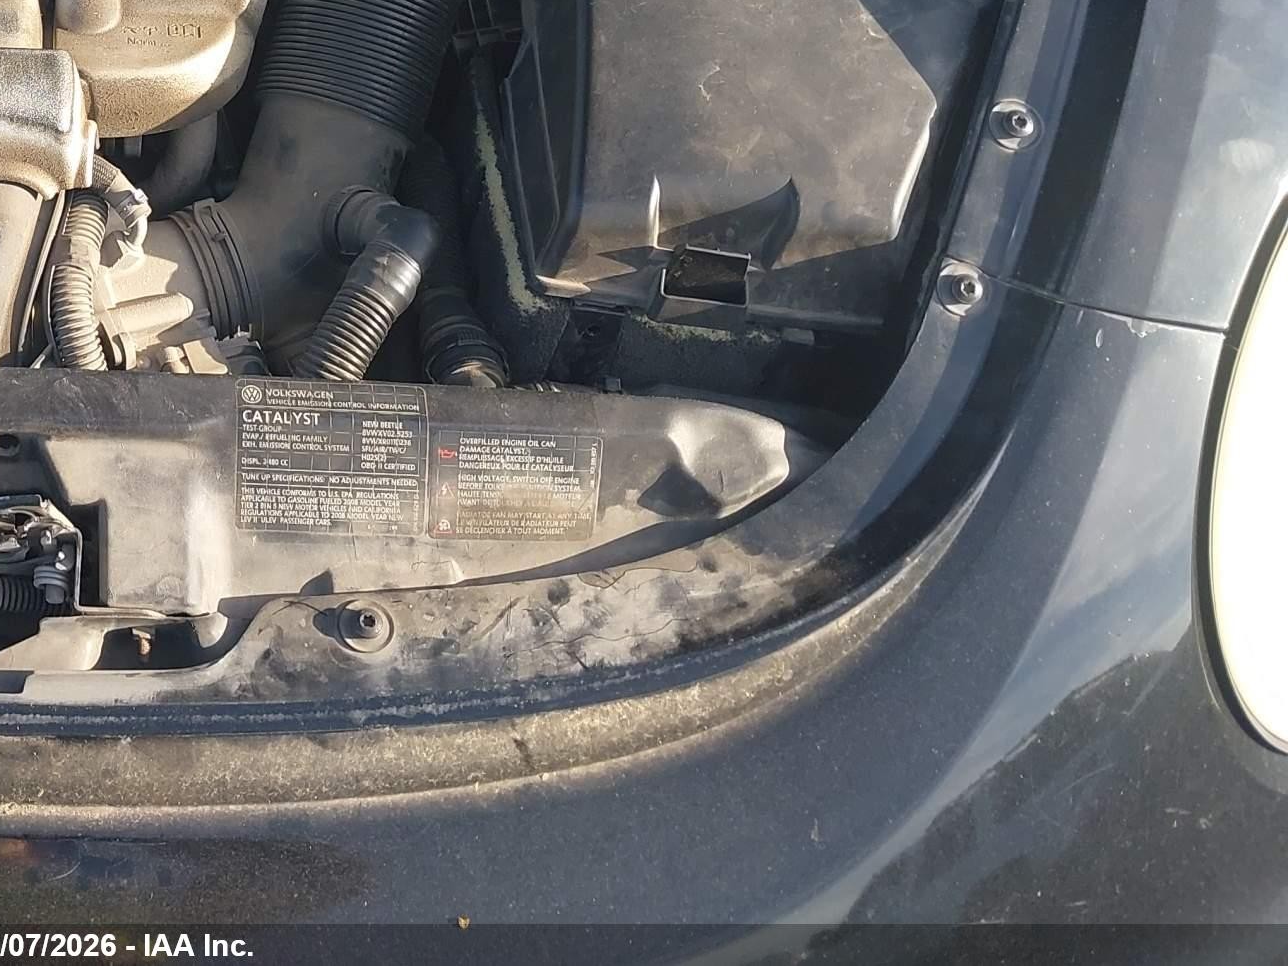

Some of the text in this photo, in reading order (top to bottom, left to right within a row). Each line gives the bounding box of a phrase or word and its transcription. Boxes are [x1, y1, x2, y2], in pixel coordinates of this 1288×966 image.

[265, 388, 333, 399] VOLKSWAGEN
[267, 398, 296, 406] VEHICLE
[333, 401, 366, 409] CONTROL
[368, 403, 419, 412] INFORMATION
[242, 410, 320, 426] CATALYST
[259, 425, 282, 433] GROUP
[380, 421, 403, 429] BEETLE
[242, 432, 259, 440] EVAP
[265, 433, 301, 442] REFUELING
[460, 437, 500, 445] OVERFILLED
[501, 438, 526, 446] ENGINE
[527, 439, 539, 447] OIL
[259, 441, 291, 449] EMISSION
[292, 443, 323, 451] CONTROL
[459, 445, 490, 453] DAMAGE
[459, 453, 504, 462] REMPLISSAGE
[506, 455, 535, 463] EXCESSIF
[384, 463, 416, 471] CERTIFIED
[459, 461, 500, 470] DANGEREUX
[241, 472, 259, 480] TUNE
[329, 476, 340, 484] NO
[341, 476, 390, 485] ADJUSTMENTS
[256, 487, 281, 495] VEHICLE
[282, 489, 317, 497] CONFORMS
[356, 492, 399, 500] REGULATIONS
[241, 494, 276, 502] APPLICABLE
[287, 496, 318, 504] GASOLINE
[319, 497, 342, 505] FUELED
[241, 501, 253, 509] TIER
[319, 504, 347, 512] VEHICLES
[364, 506, 401, 514] CALIFORNIA
[261, 516, 277, 524] ULEV
[279, 517, 314, 525] PASSENGER
[283, 510, 319, 518] APPLICABLE
[370, 513, 387, 521] YEAR
[514, 527, 531, 535] TOUT
